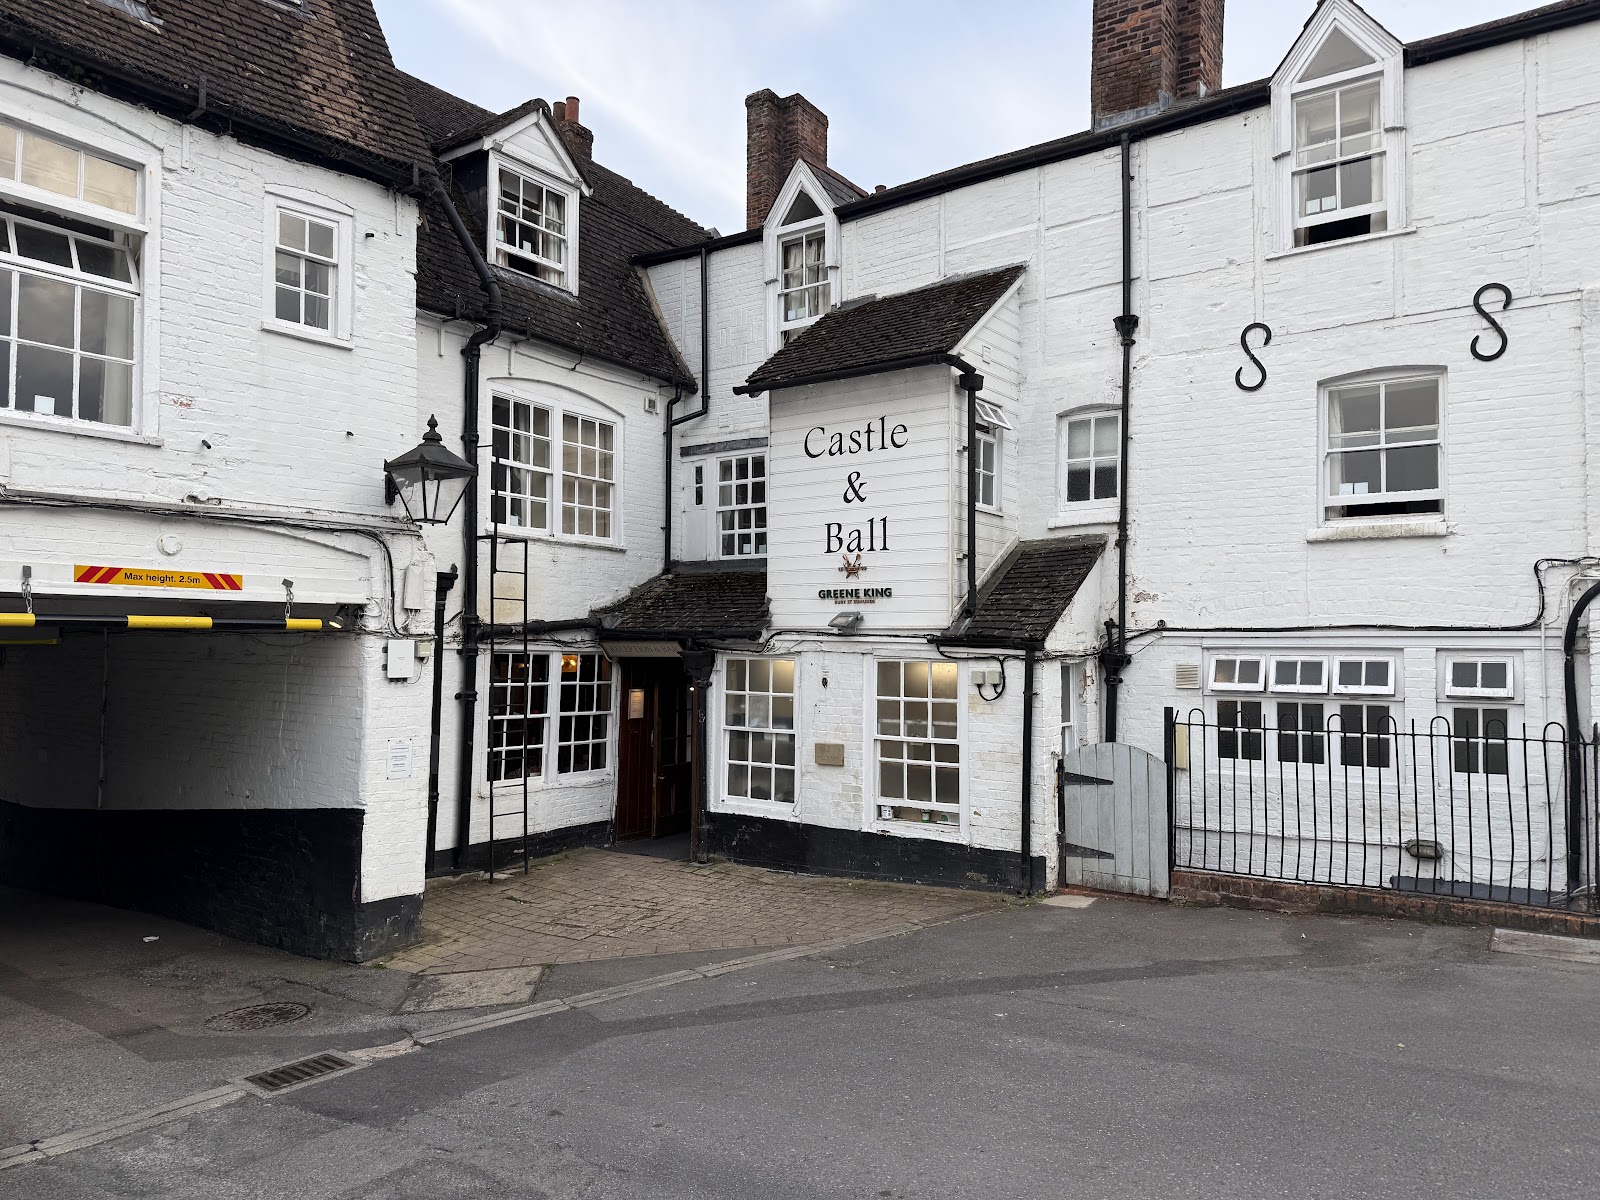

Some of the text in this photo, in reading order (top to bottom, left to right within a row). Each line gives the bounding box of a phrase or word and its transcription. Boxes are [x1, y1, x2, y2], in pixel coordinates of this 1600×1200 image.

[804, 415, 908, 459] Castle
[843, 471, 867, 503] &
[824, 516, 889, 553] Ball
[124, 572, 143, 581] Max
[179, 576, 201, 584] 2.5m
[818, 588, 892, 599] GREENE KING
